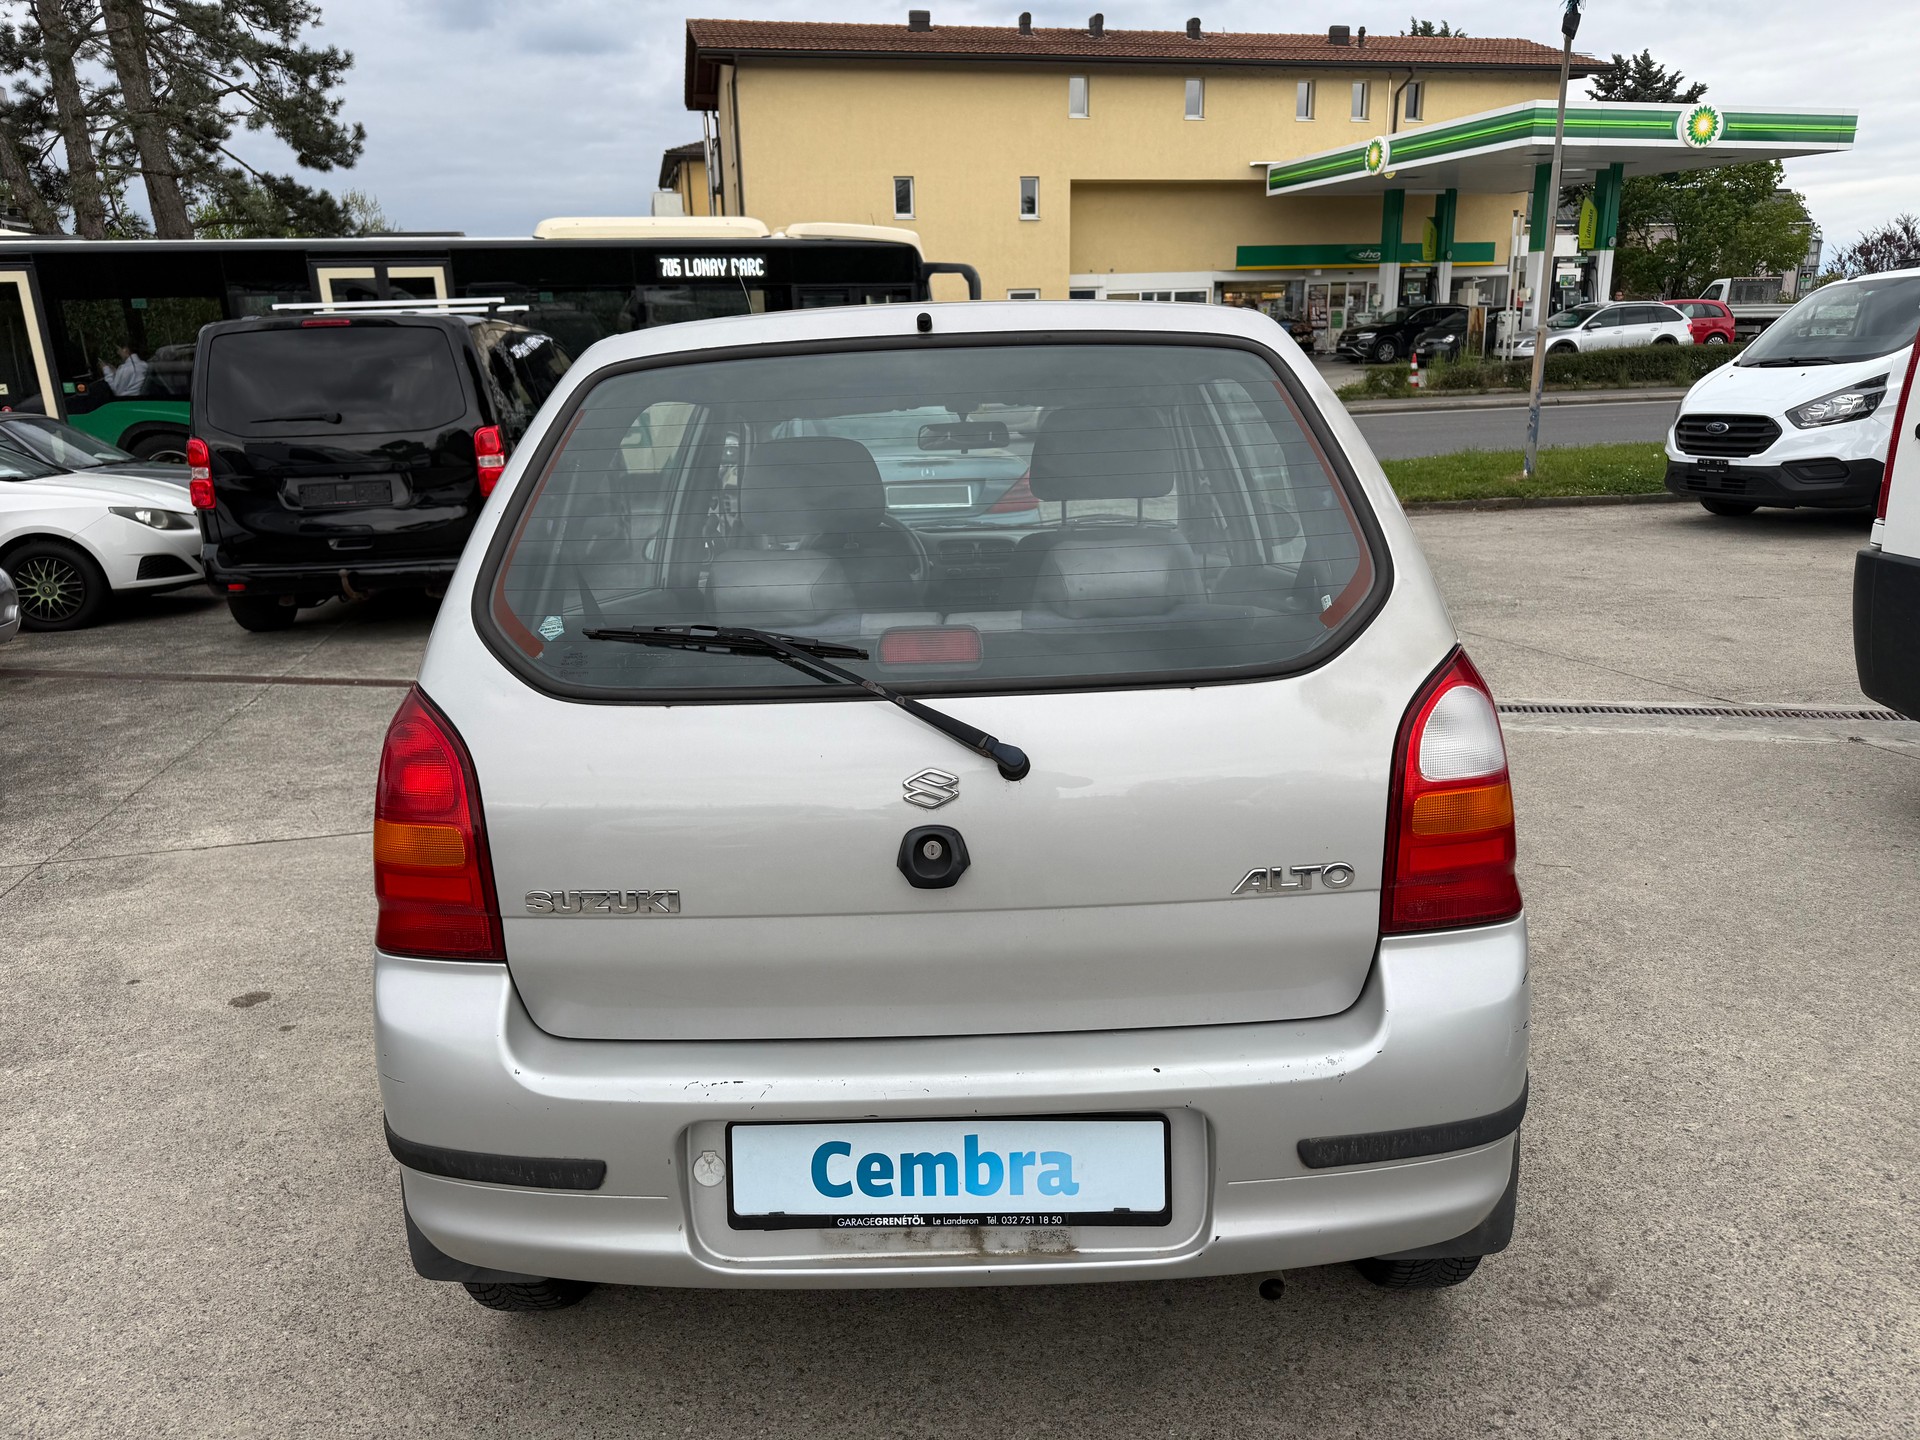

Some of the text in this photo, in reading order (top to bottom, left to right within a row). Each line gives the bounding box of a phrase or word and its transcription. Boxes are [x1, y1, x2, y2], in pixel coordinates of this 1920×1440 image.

[1358, 249, 1381, 259] sho
[659, 258, 764, 277] 705 LONAY PARC
[1231, 861, 1356, 895] ALTO
[525, 890, 681, 914] SUZUKI
[811, 1134, 1080, 1198] Cembra
[932, 1216, 941, 1225] Le
[943, 1216, 979, 1225] Landeron
[986, 1215, 999, 1225] Tél.
[1001, 1216, 1017, 1225] 032
[1020, 1216, 1035, 1225] 751
[1039, 1215, 1049, 1224] 18
[1051, 1215, 1062, 1224] 50
